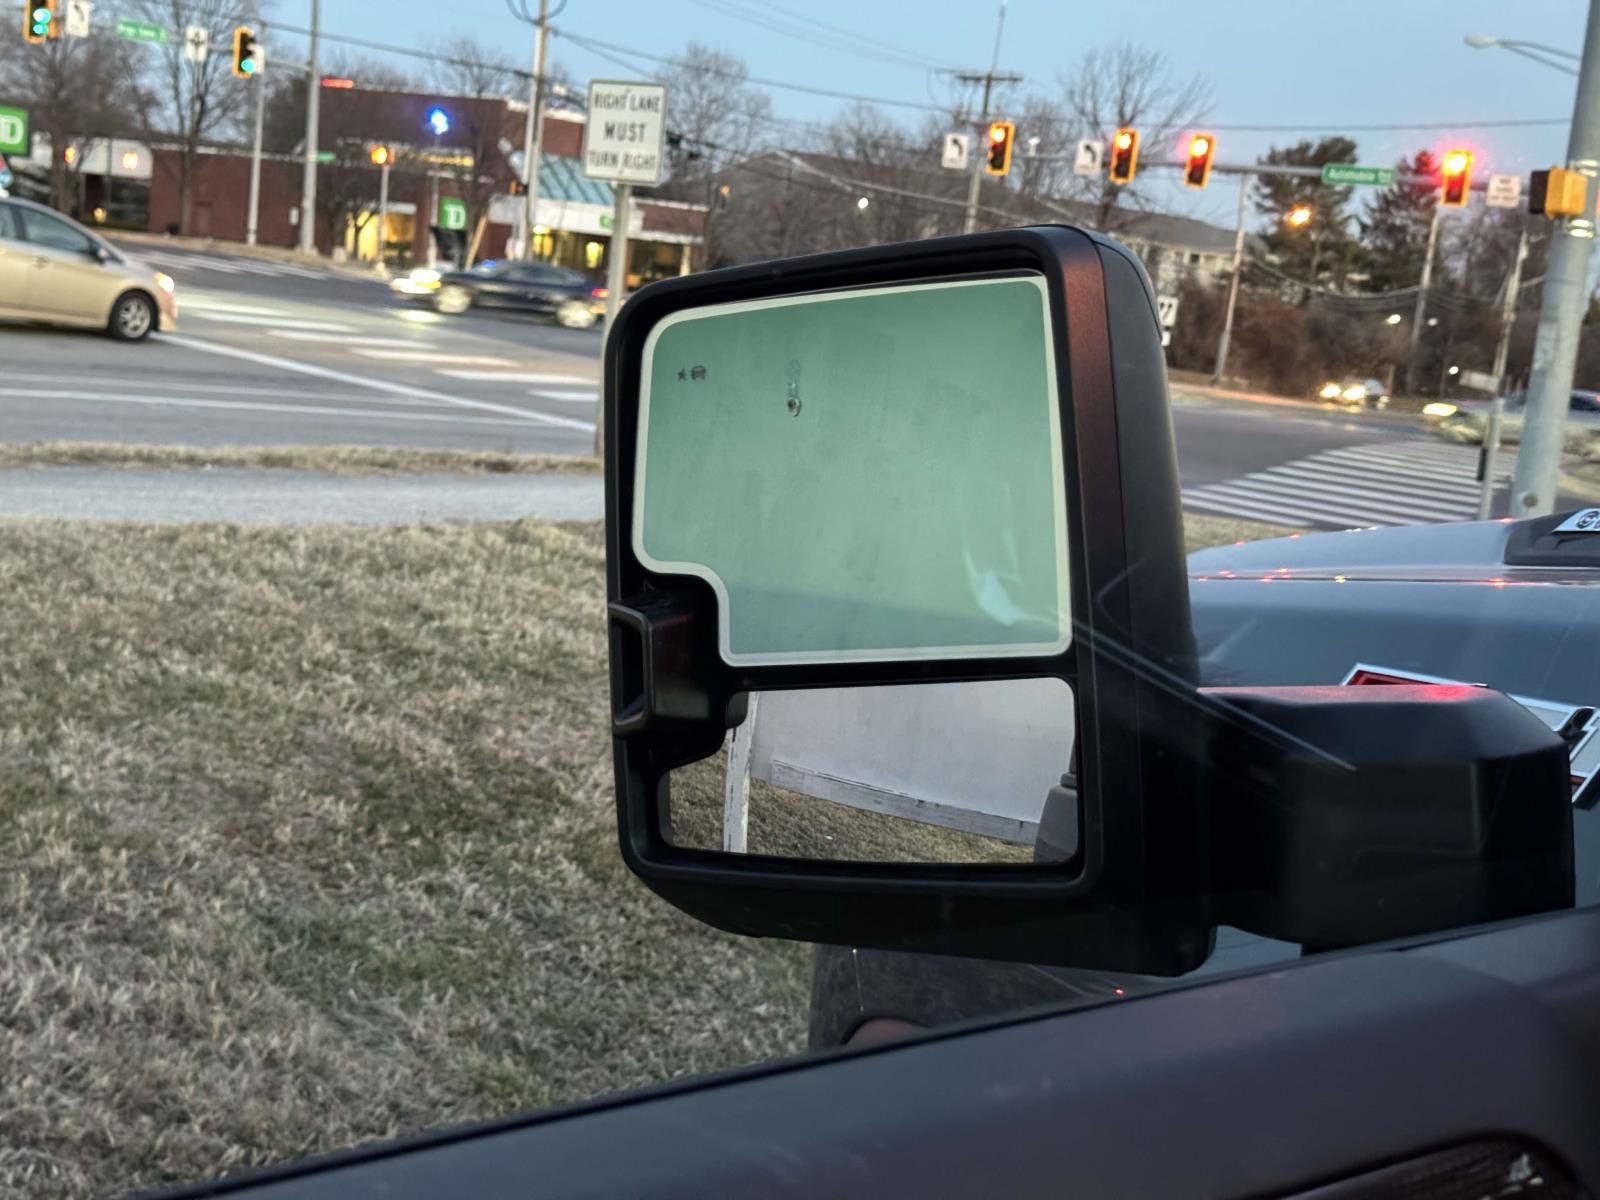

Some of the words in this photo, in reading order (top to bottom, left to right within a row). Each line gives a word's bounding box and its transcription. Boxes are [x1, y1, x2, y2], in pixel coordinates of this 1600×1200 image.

[593, 91, 627, 110] RIGHT
[630, 94, 661, 113] LANE
[603, 121, 647, 143] MUST
[588, 151, 618, 168] TURN
[622, 153, 657, 170] RIGHT
[443, 204, 466, 230] TD
